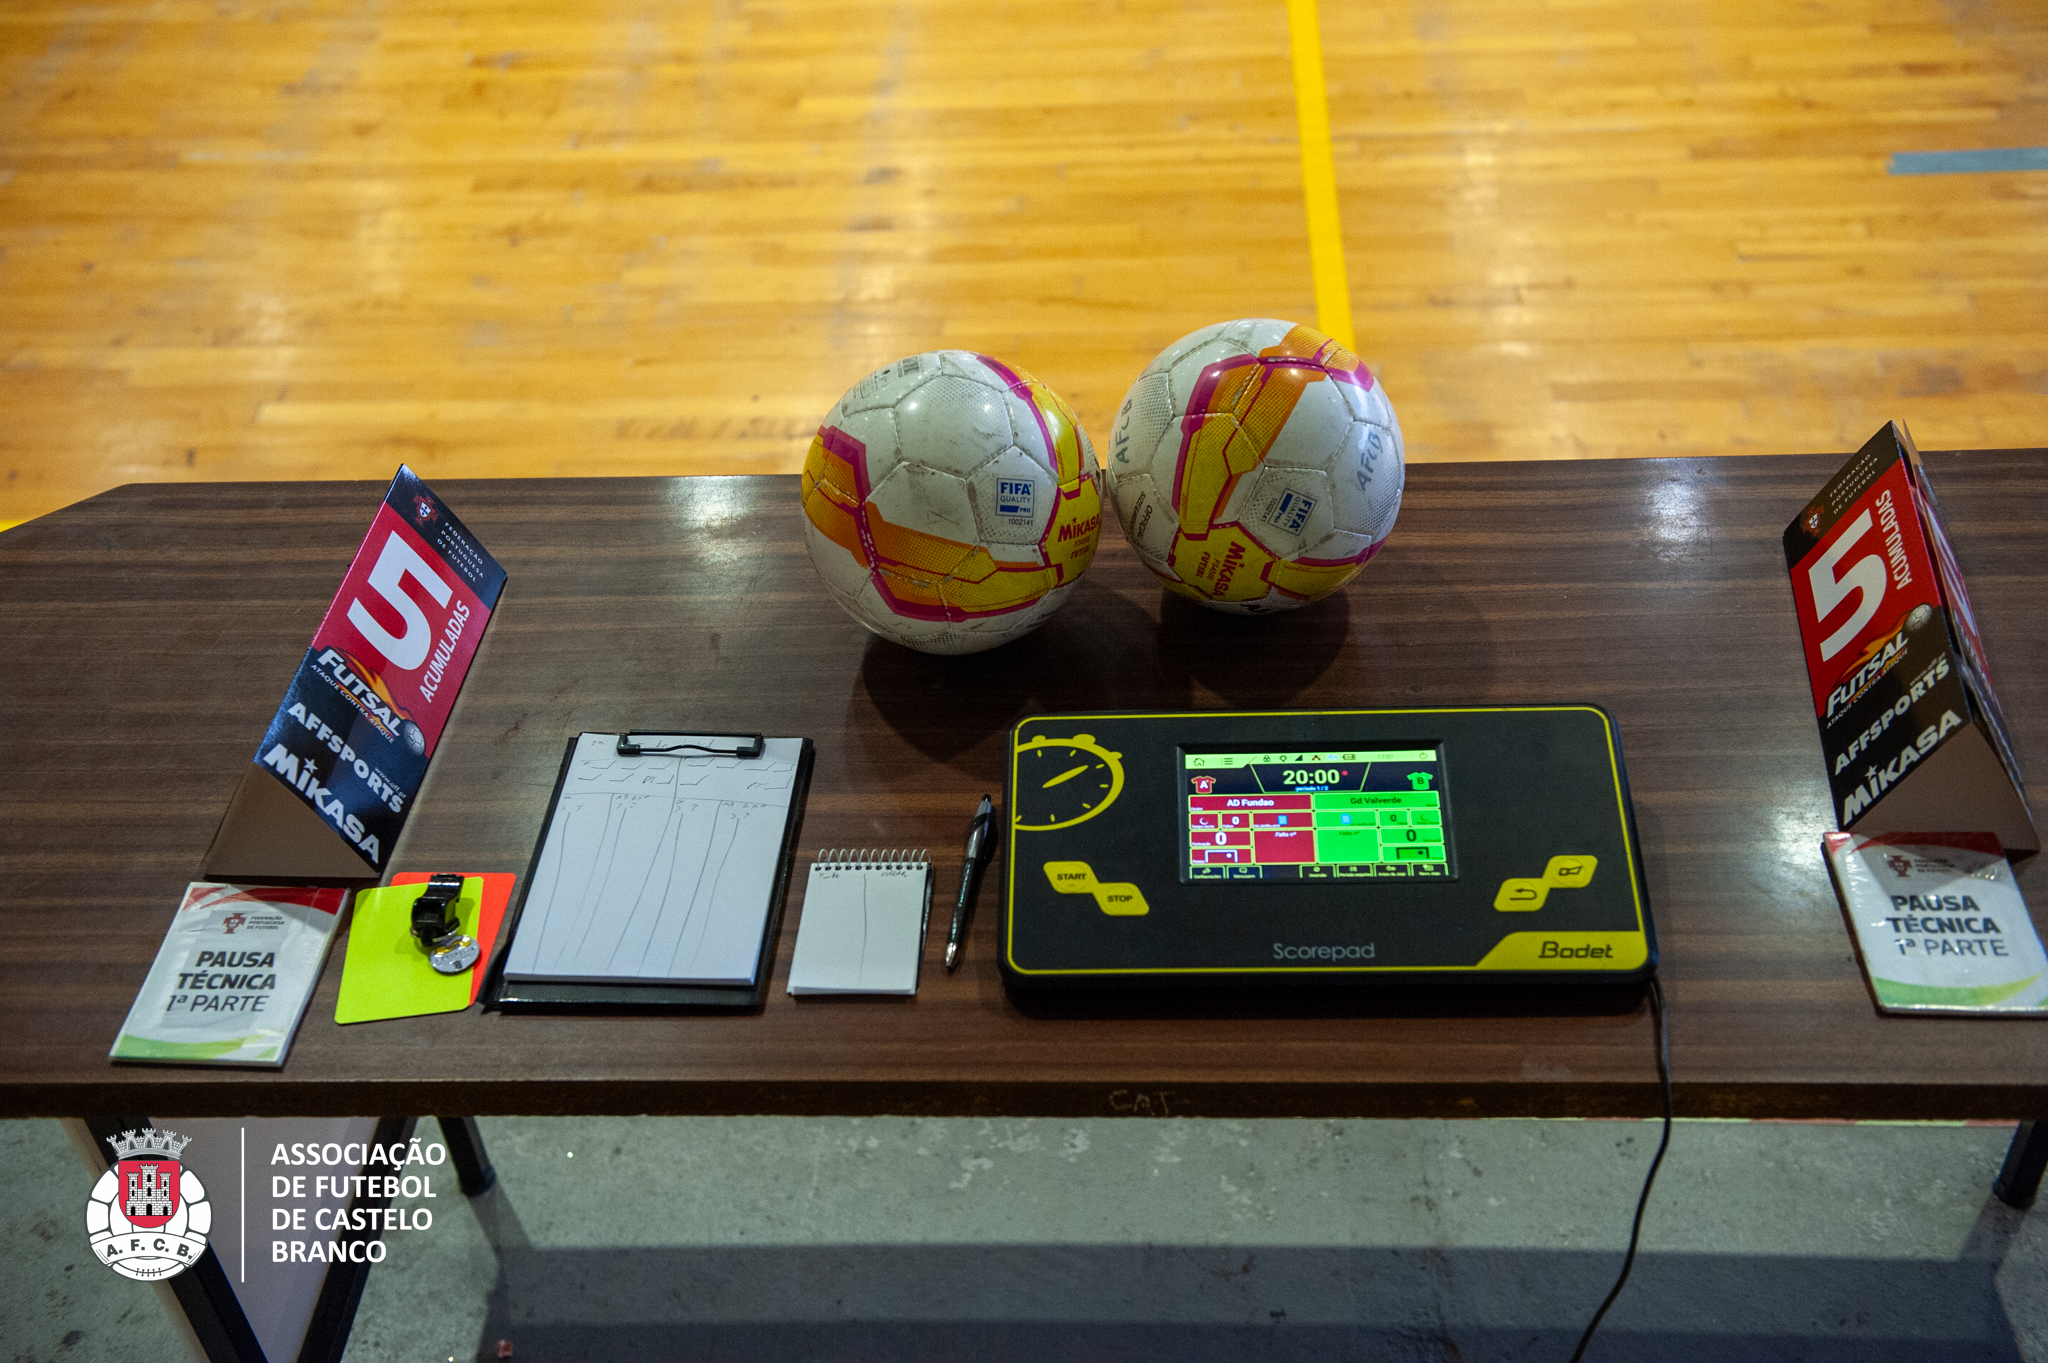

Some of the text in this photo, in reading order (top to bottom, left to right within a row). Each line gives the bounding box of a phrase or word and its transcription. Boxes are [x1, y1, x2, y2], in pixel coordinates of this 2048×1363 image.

[1829, 453, 1871, 498] FEDERAÇÃO
[1831, 457, 1878, 506] PORTUGUESA
[1000, 482, 1031, 495] FIFA
[1833, 469, 1876, 515] DE FUTEBOL
[1000, 495, 1031, 504] QUALITY
[1008, 518, 1034, 526] 1002141
[1282, 496, 1301, 528] QUALITY
[1288, 499, 1312, 530] FIFA
[445, 522, 483, 565] FEDERAÇÃO
[1875, 489, 1913, 590] ACUMULADAS
[437, 538, 476, 582] DE FUTEBOL
[441, 530, 484, 578] PORTUGUESA
[1808, 508, 1888, 663] 5
[347, 530, 453, 670] 5
[419, 600, 470, 703] ACUMULADAS
[1827, 631, 1909, 718] FUTSAL
[317, 649, 401, 737] FUTSAL
[310, 664, 396, 744] ATAQUE CONTRA ATAQUE
[1827, 702, 1852, 729] ATAQUE
[1834, 659, 1950, 776] AFFSPORTS
[287, 701, 404, 814] AFFSPORTS
[1199, 780, 1209, 789] A
[1283, 769, 1340, 785] 20:00
[1417, 777, 1425, 785] B
[1227, 798, 1275, 807] AD Fundao
[1364, 796, 1402, 804] Valverde
[1231, 816, 1240, 825] 0
[1390, 814, 1397, 822] 0
[1215, 831, 1227, 846] 0
[1406, 829, 1416, 842] 0
[1057, 873, 1087, 881] START
[1107, 895, 1133, 903] STOP
[1890, 895, 1981, 912] PAUSA
[1886, 914, 2002, 934] TÉCNICA
[1273, 942, 1376, 962] Scorepad
[1538, 940, 1614, 959] Bodet
[1923, 939, 2010, 957] PARTE
[195, 950, 276, 969] PAUSA
[177, 969, 276, 991] TÉCNICA
[166, 994, 270, 1013] 1ª PARTE
